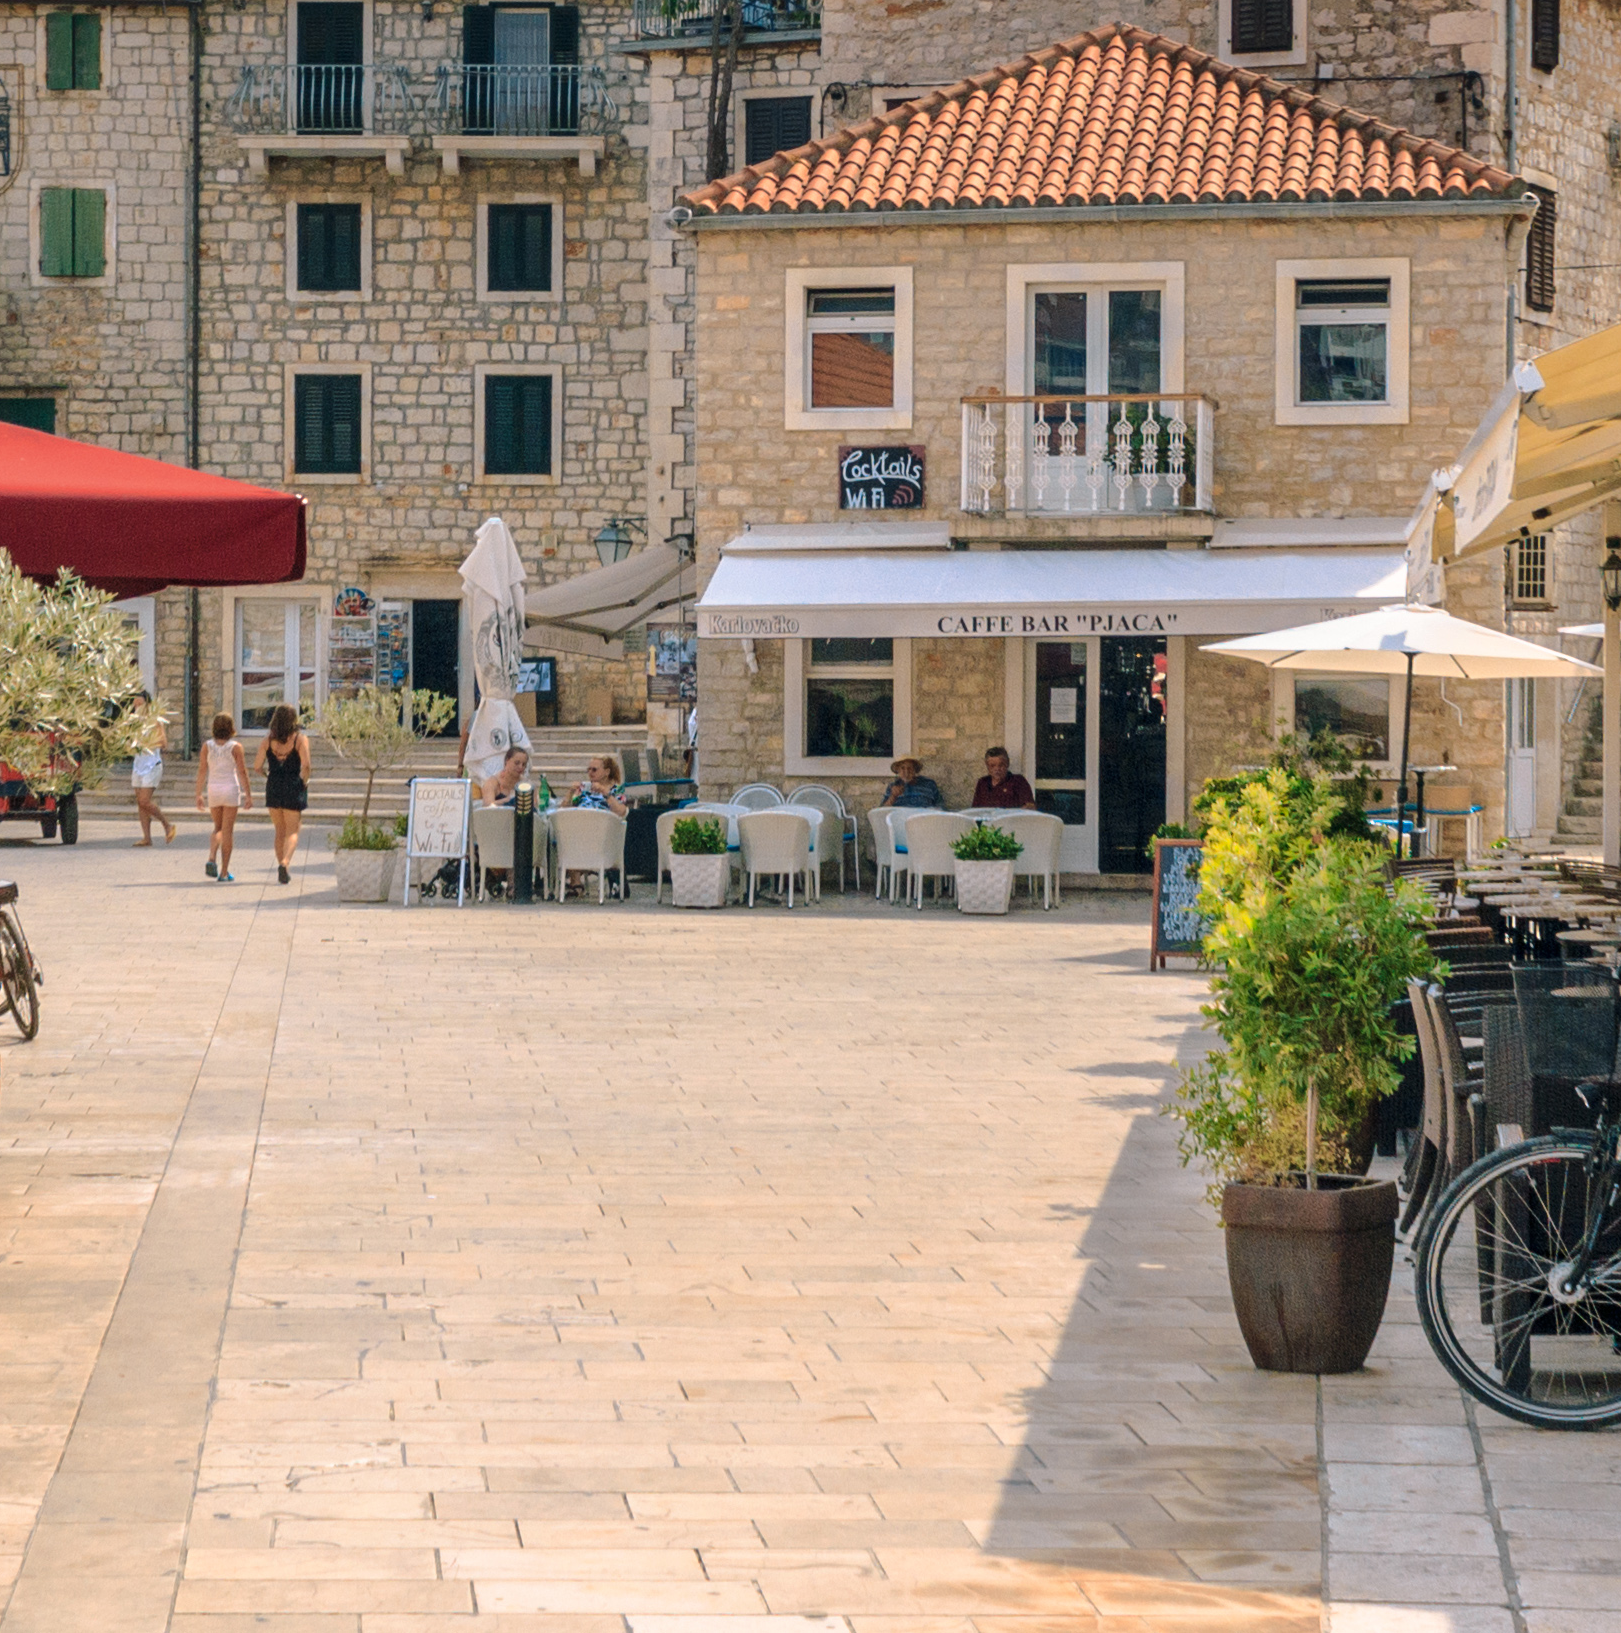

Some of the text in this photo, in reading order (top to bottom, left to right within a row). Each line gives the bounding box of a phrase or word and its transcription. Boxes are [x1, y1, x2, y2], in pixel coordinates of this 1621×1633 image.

[841, 450, 922, 489] Cocktails
[709, 614, 800, 634] Karlovačko
[937, 614, 1178, 633] CAFFE BAR "PJACA"
